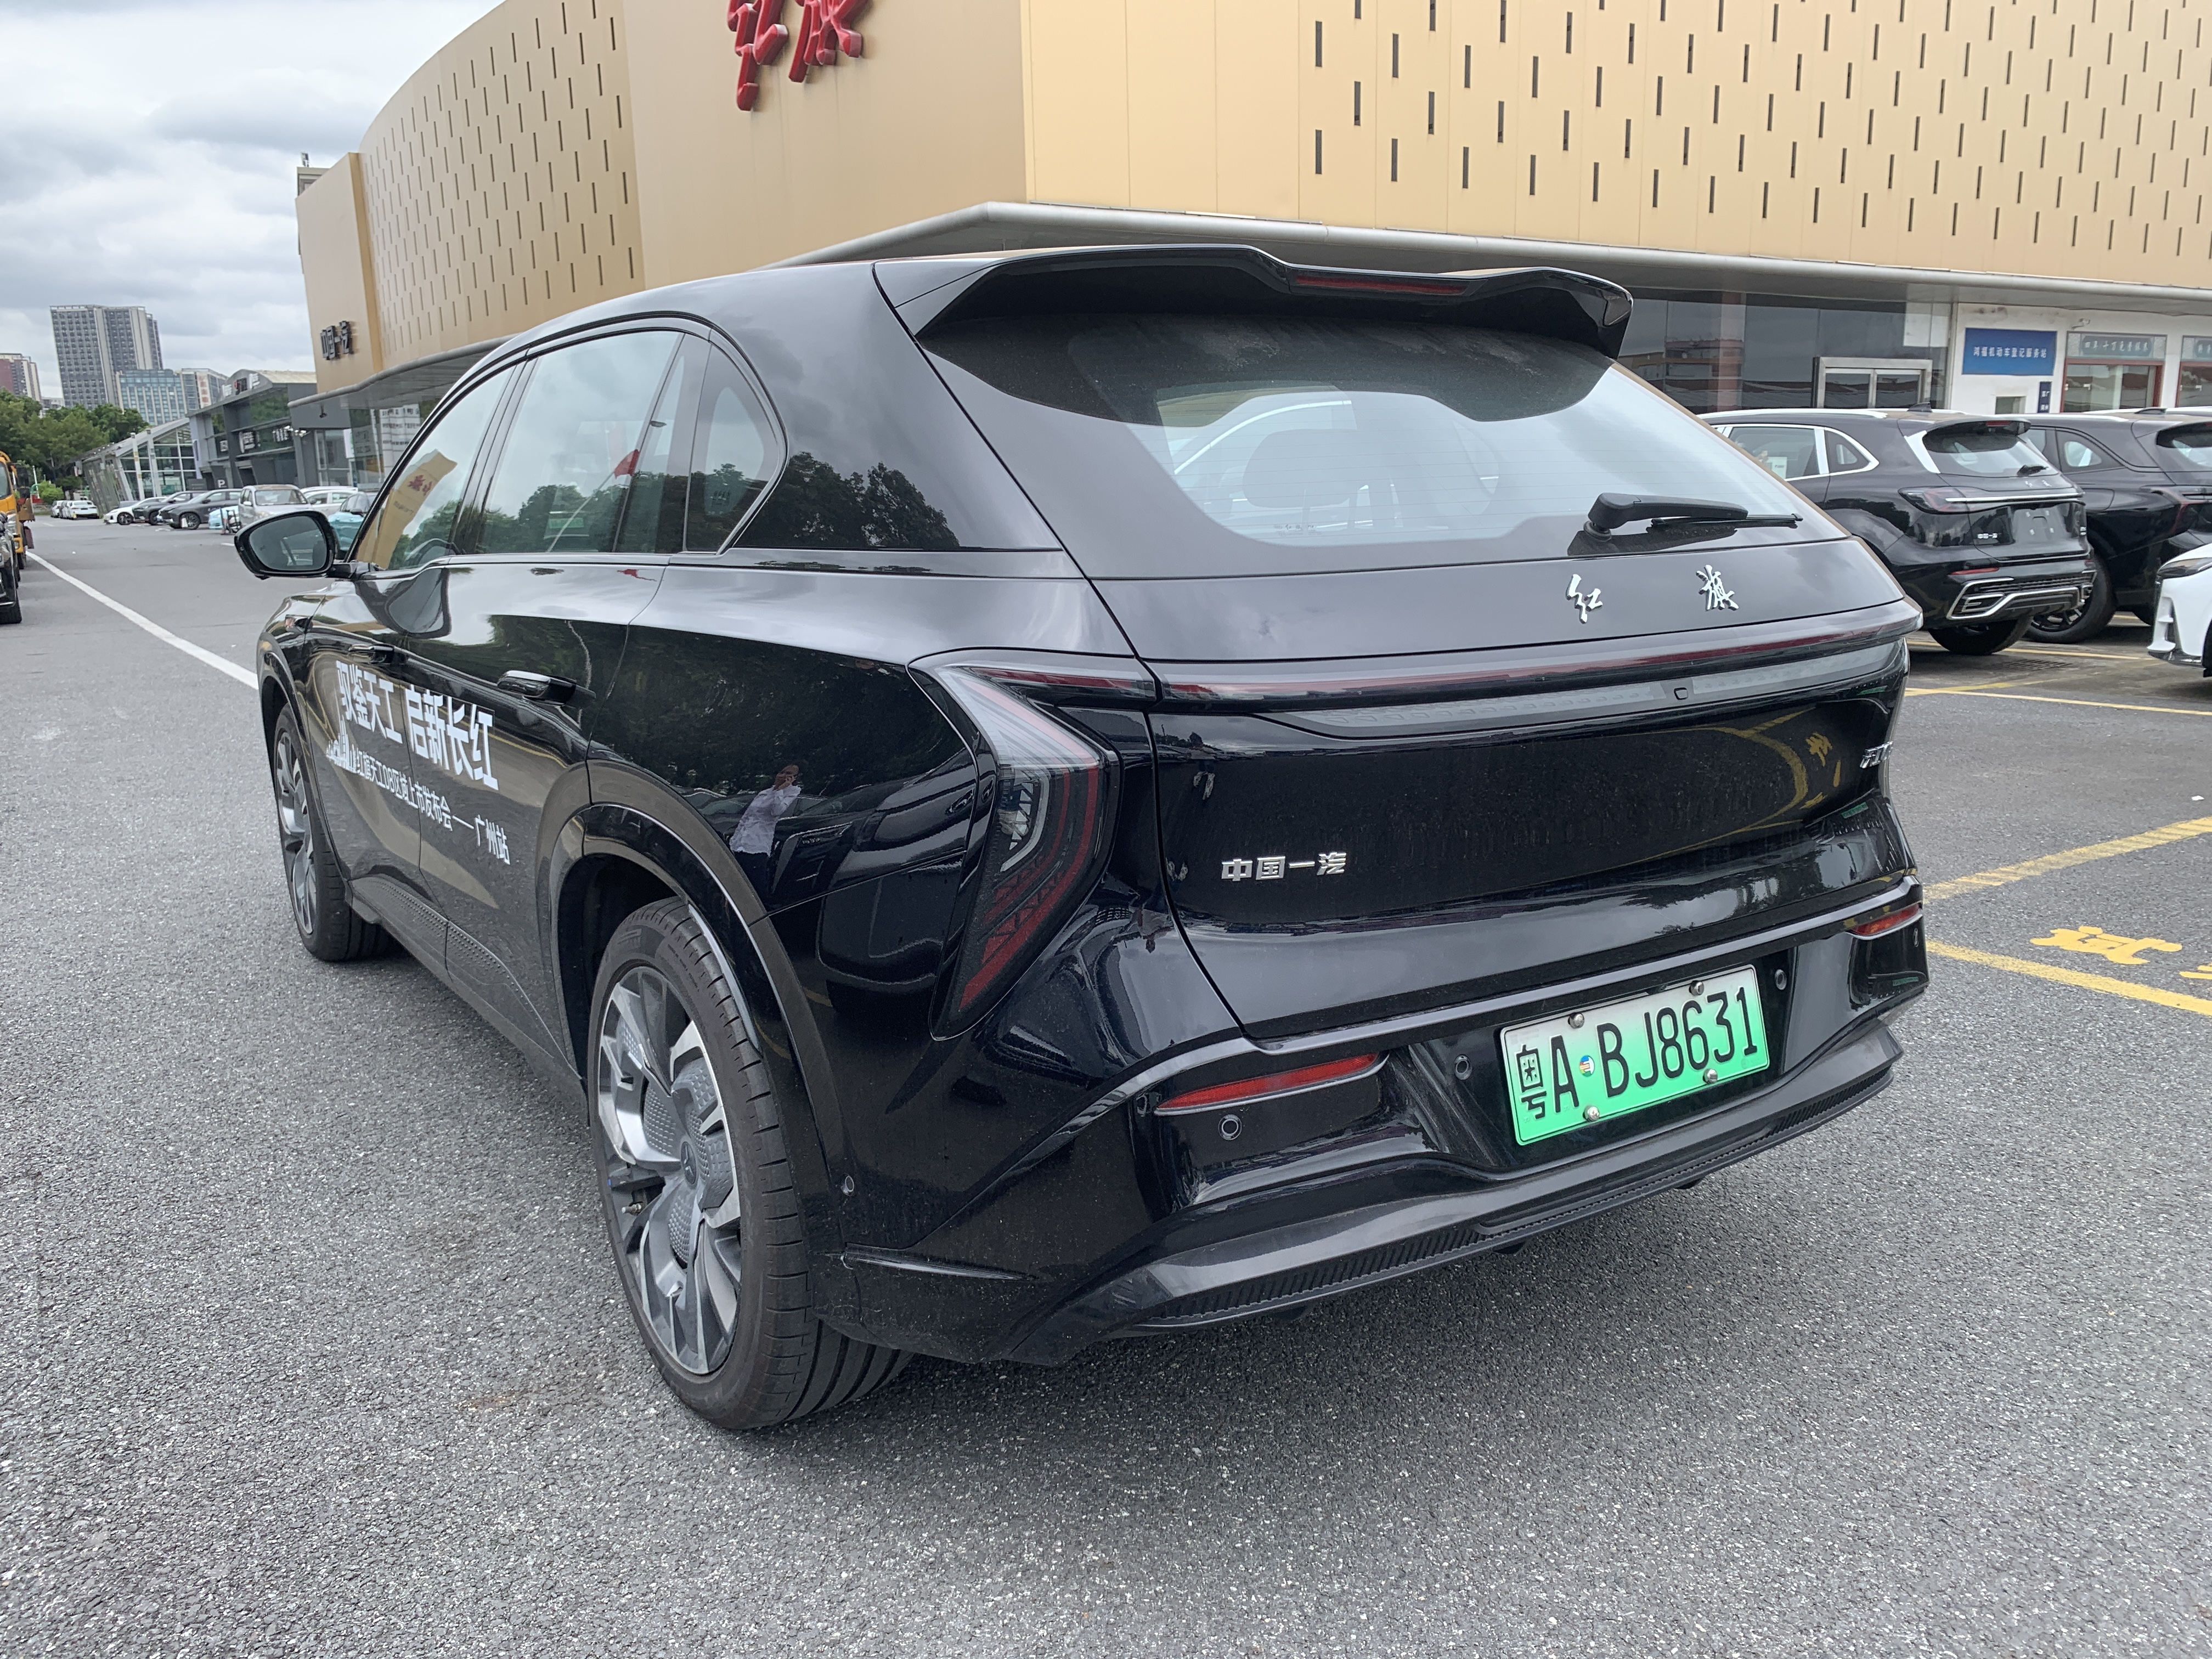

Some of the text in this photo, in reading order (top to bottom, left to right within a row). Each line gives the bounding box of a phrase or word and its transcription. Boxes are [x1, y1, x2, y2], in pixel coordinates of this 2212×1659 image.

[1566, 565, 1740, 624] 红旗
[336, 660, 499, 791] 驭鉴天工 启新长红
[1221, 851, 1347, 882] 中国一汽
